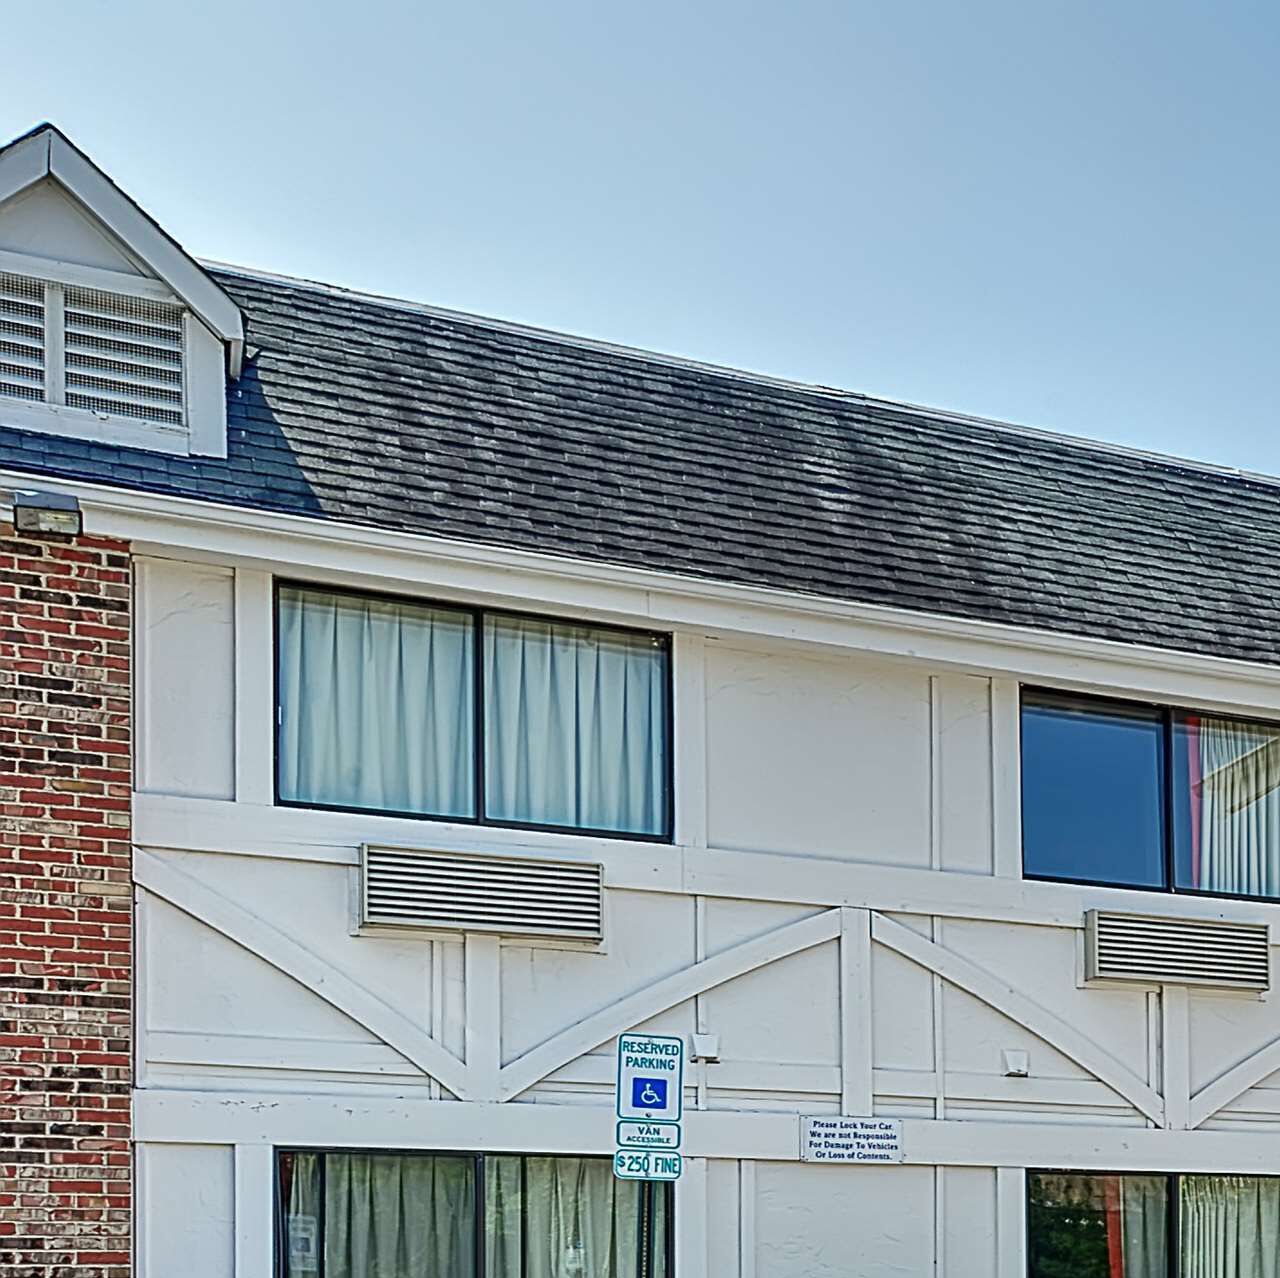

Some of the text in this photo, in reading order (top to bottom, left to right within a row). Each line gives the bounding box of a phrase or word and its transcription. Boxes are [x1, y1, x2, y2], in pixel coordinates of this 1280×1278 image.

[622, 1041, 679, 1056] RESERVED
[625, 1056, 675, 1071] PARKING
[813, 1120, 837, 1129] Please
[840, 1121, 858, 1129] Lock
[860, 1122, 877, 1130] Your
[637, 1126, 660, 1136] VAN
[809, 1130, 821, 1138] We
[853, 1132, 897, 1141] Responsible
[626, 1136, 672, 1144] ACCESSIBLE
[809, 1140, 821, 1148] For
[824, 1141, 853, 1150] Damage
[867, 1142, 898, 1150] Vehicles
[828, 1151, 845, 1159] Loss
[856, 1152, 892, 1160] Contents.
[616, 1155, 680, 1174] $250 FINE
